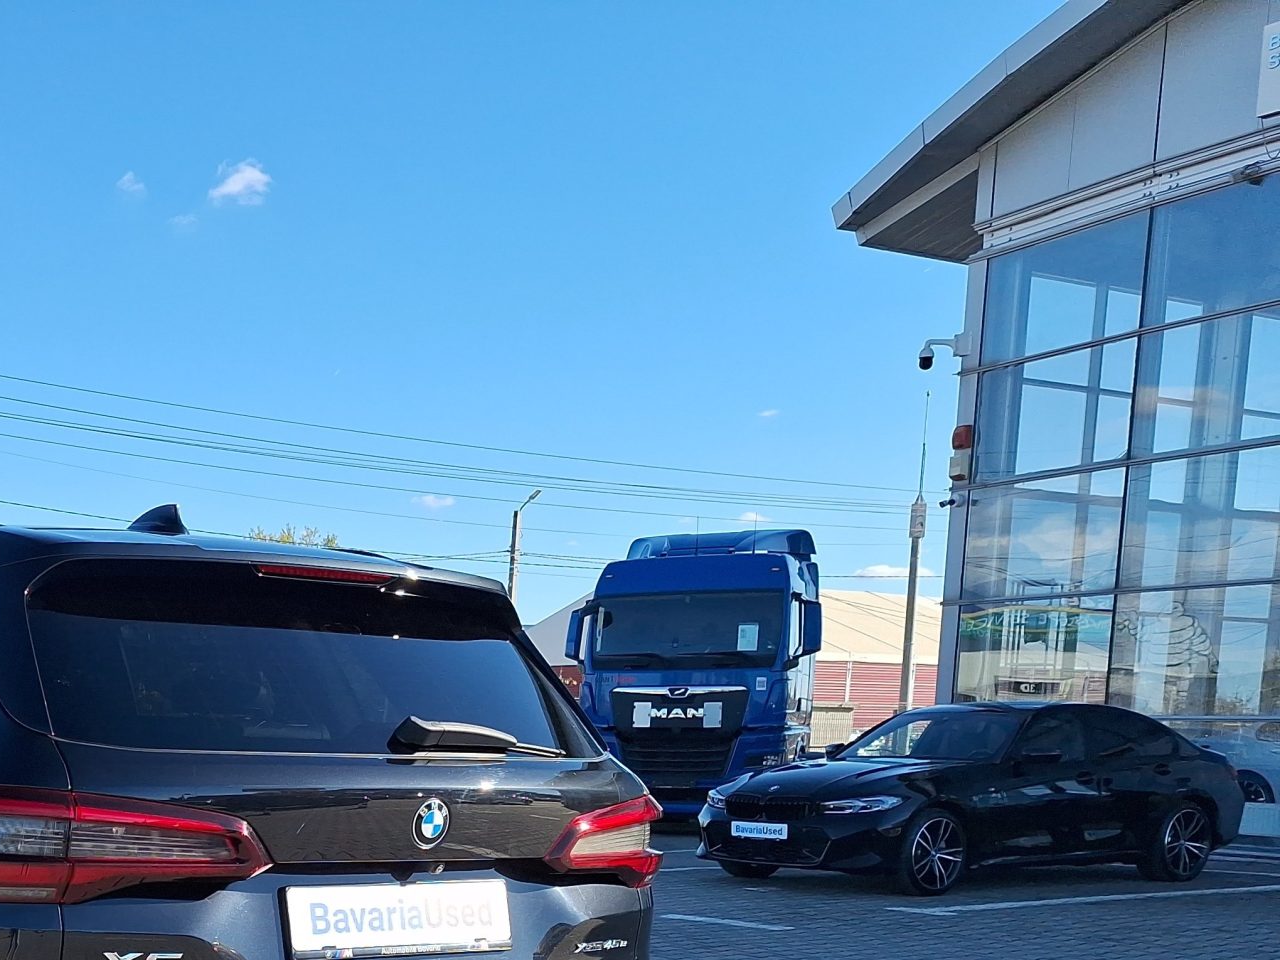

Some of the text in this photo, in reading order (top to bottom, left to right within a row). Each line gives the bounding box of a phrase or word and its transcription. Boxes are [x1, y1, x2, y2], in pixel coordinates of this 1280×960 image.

[650, 708, 704, 719] MAN
[735, 825, 783, 836] BavariaUsed
[310, 898, 492, 935] BavariaUsed
